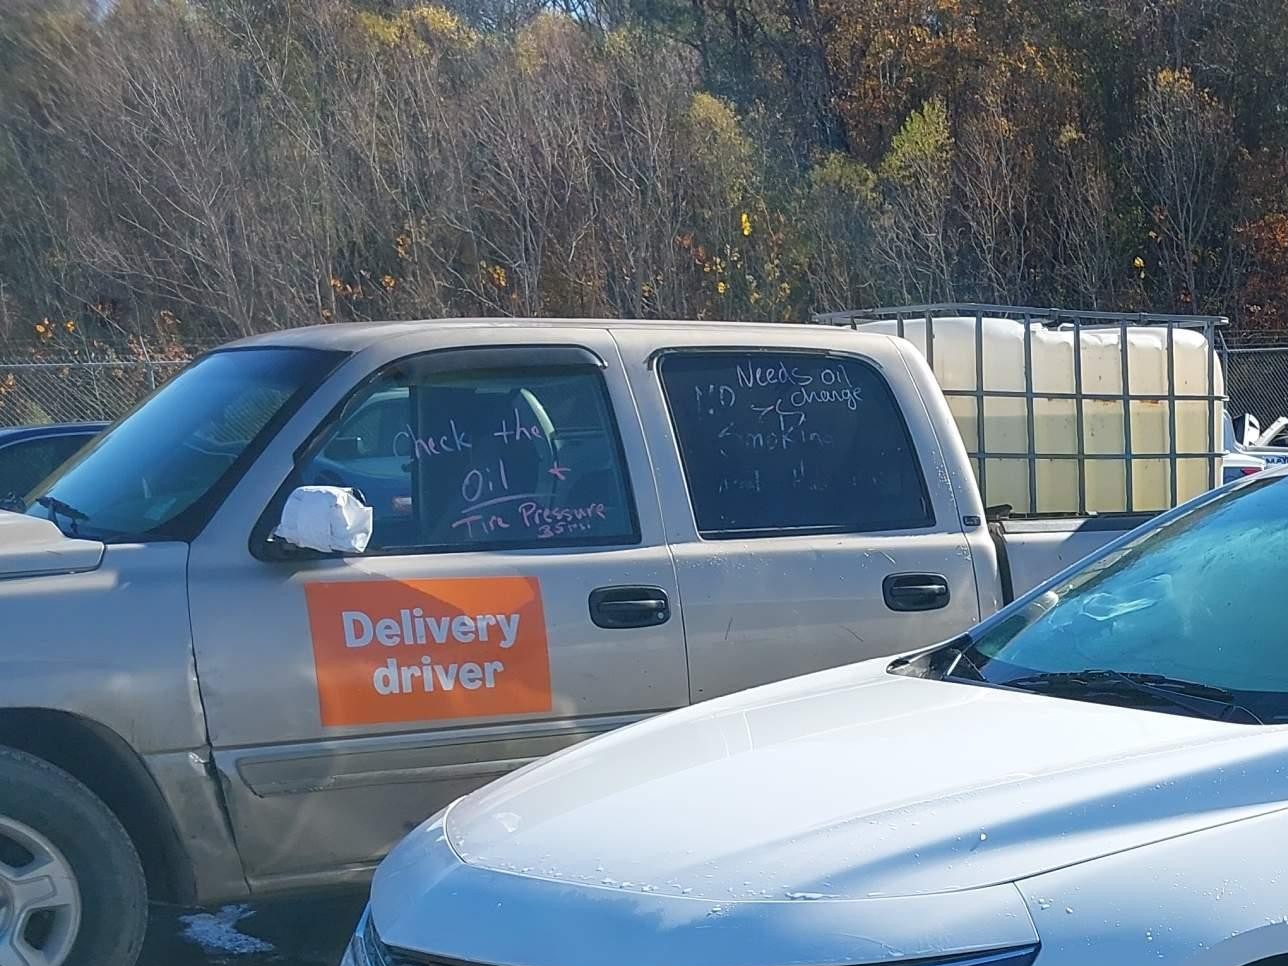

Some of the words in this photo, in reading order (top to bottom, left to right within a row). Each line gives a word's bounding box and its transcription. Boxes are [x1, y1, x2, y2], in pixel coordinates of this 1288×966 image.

[737, 359, 812, 388] Needs
[791, 386, 863, 411] change
[393, 419, 473, 458] Check
[494, 408, 544, 445] the
[462, 459, 508, 502] Oil
[452, 514, 511, 538] Tire
[518, 502, 607, 527] Pressure
[342, 607, 520, 649] Delivery
[373, 655, 504, 695] driver
